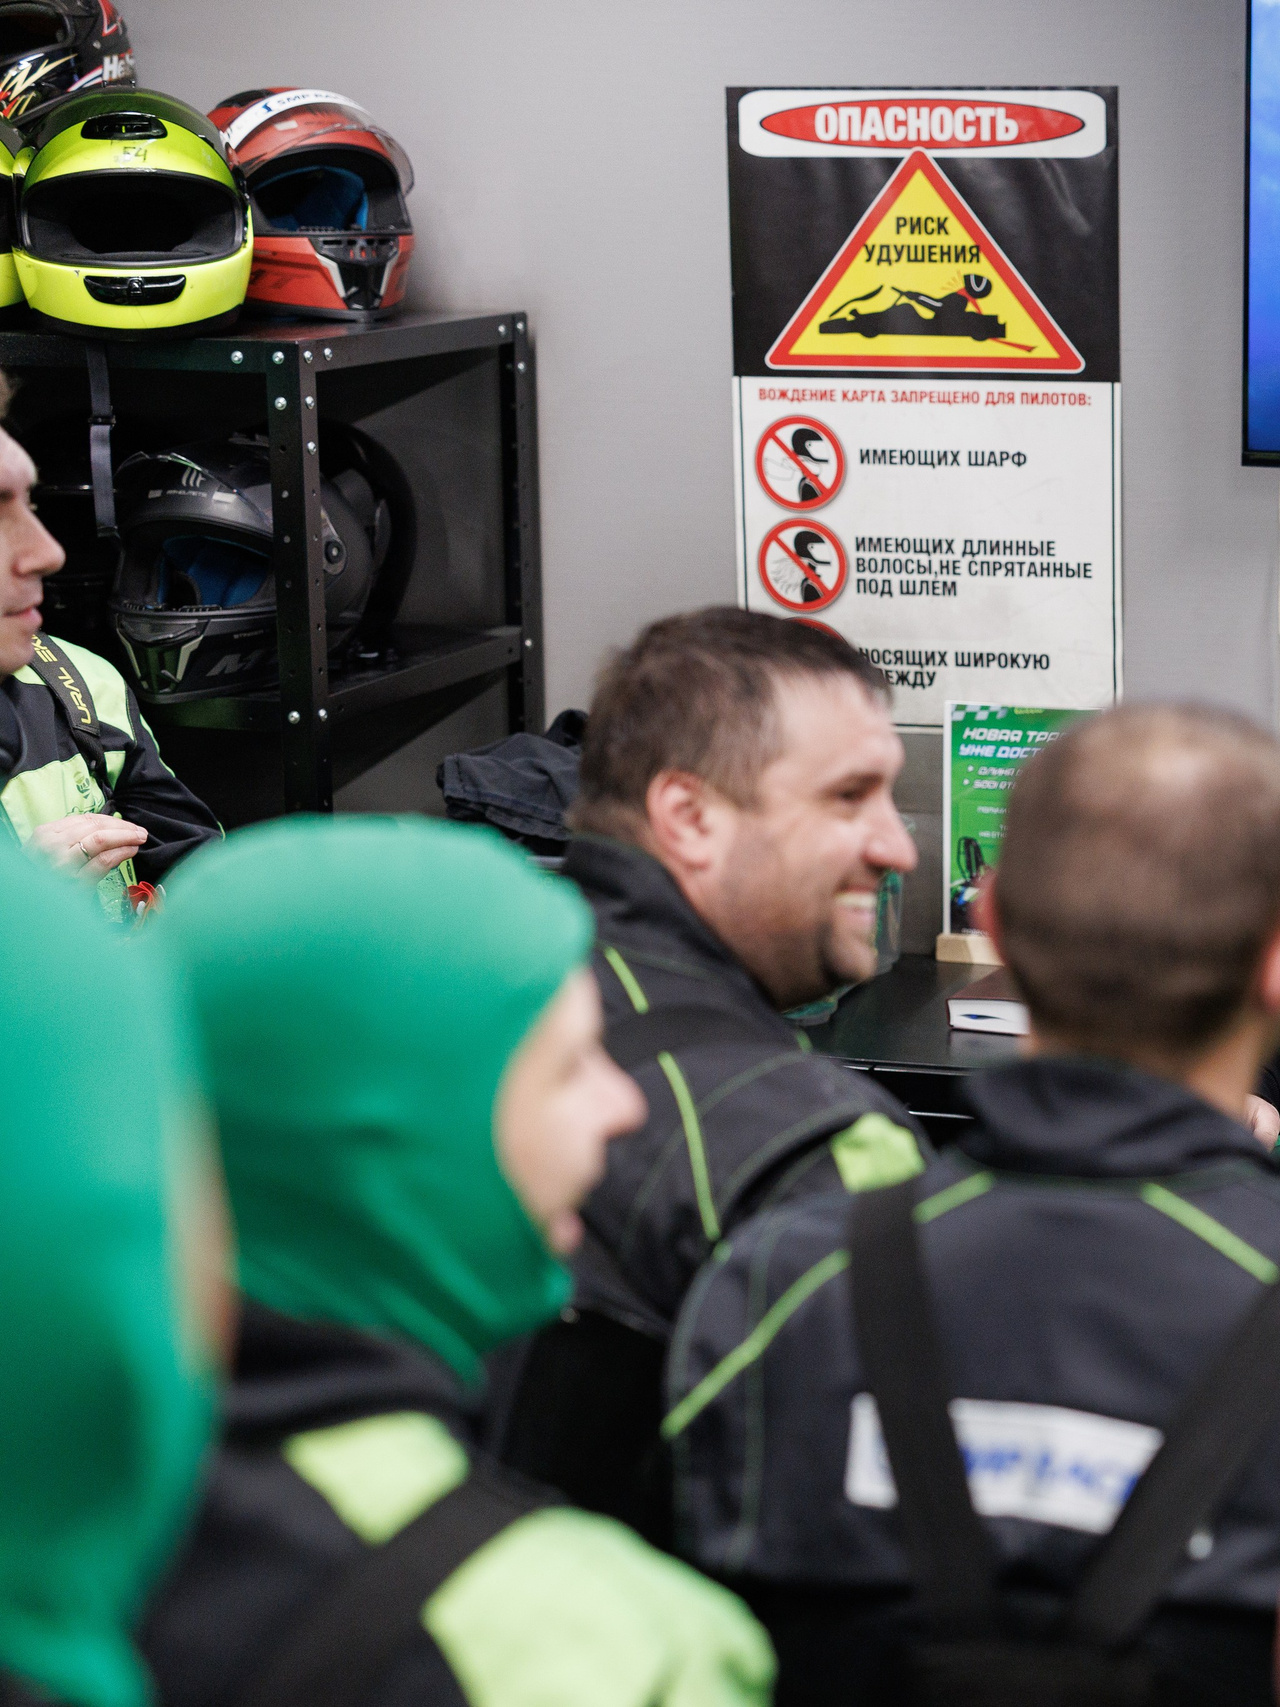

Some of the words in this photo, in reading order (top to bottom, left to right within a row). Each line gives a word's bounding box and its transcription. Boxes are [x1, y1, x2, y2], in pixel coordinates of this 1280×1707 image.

[814, 105, 1019, 142] ОПАСНОСТЬ
[895, 216, 949, 236] РИСК
[864, 244, 981, 266] УДУШЕНИЯ
[758, 388, 836, 403] ВОЖДЕНИЕ
[842, 390, 886, 403] КАРТА
[891, 390, 980, 405] ЗАПРЕЩЕНО
[985, 392, 1015, 406] ДЛЯ
[1021, 392, 1092, 406] ПИЛОТОВ:
[860, 449, 961, 469] ИМЕЮЩИХ
[968, 451, 1028, 468] ШАРФ
[856, 537, 955, 556] ИМЕЮЩИХ
[962, 539, 1056, 558] ДЛИННЫЕ
[968, 560, 1093, 579] СПРЯТАННЫЕ
[857, 579, 893, 598] ПОД
[899, 580, 957, 597] ШЛЕМ
[955, 651, 1050, 670] ШИРОКУЮ
[883, 669, 937, 690] ЕЖДУ
[58, 666, 92, 725] URAL
[962, 727, 1023, 743] НОВАЯ
[1026, 731, 1066, 743] ТРА
[996, 746, 1043, 759] ДОСТ
